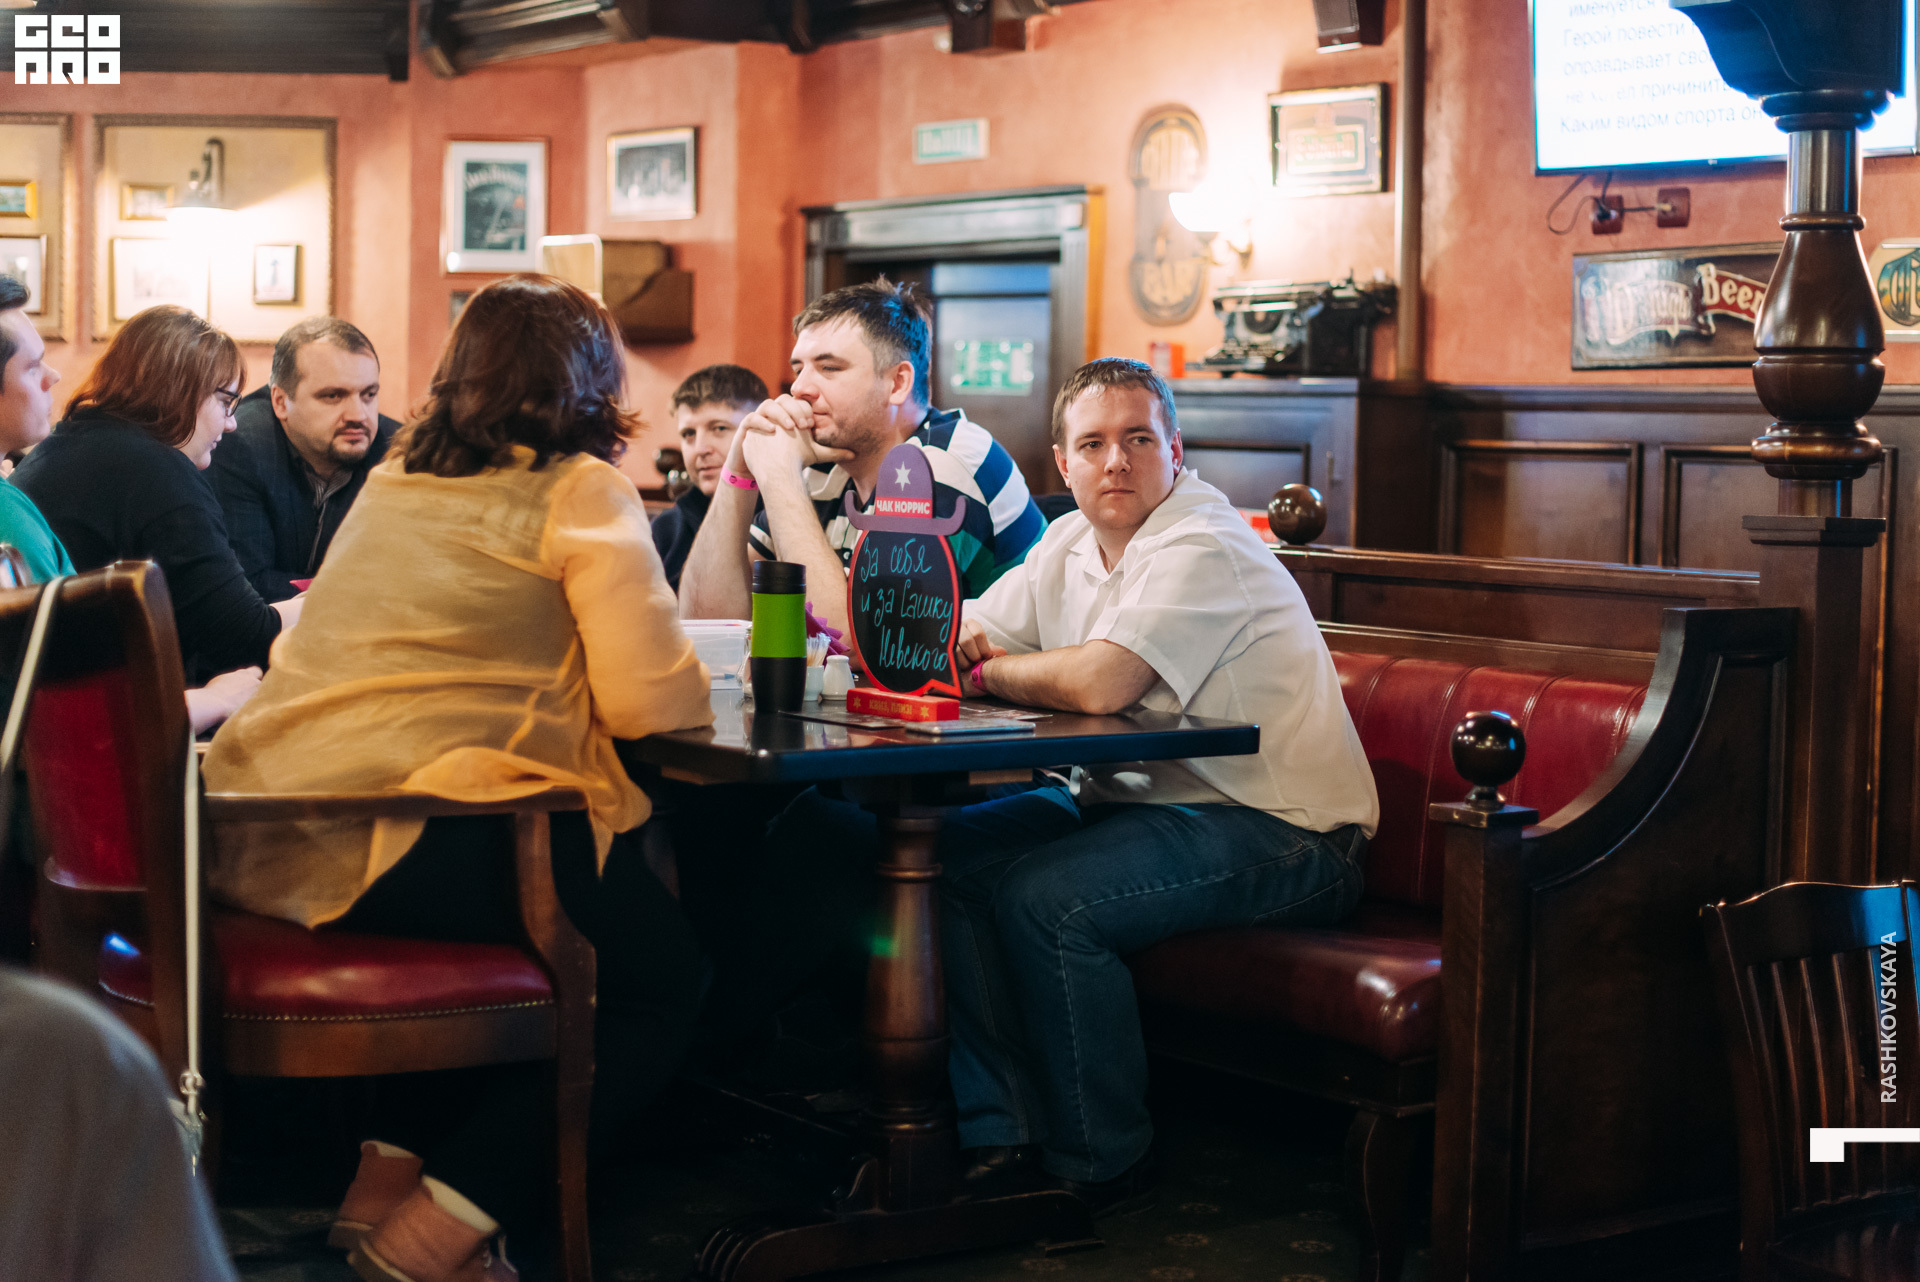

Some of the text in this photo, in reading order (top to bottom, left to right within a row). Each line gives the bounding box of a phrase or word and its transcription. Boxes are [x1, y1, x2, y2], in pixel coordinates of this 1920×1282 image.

[1563, 25, 1612, 48] Герой
[1617, 21, 1686, 42] повести
[1563, 52, 1673, 77] оправдывает
[1560, 116, 1611, 134] Каким
[1616, 113, 1669, 132] видом
[1674, 106, 1735, 127] спорта
[876, 499, 931, 515] ЧАК НОРРИС
[860, 536, 933, 583] За себя
[861, 578, 954, 644] и за Сашку
[878, 624, 949, 672] Невского
